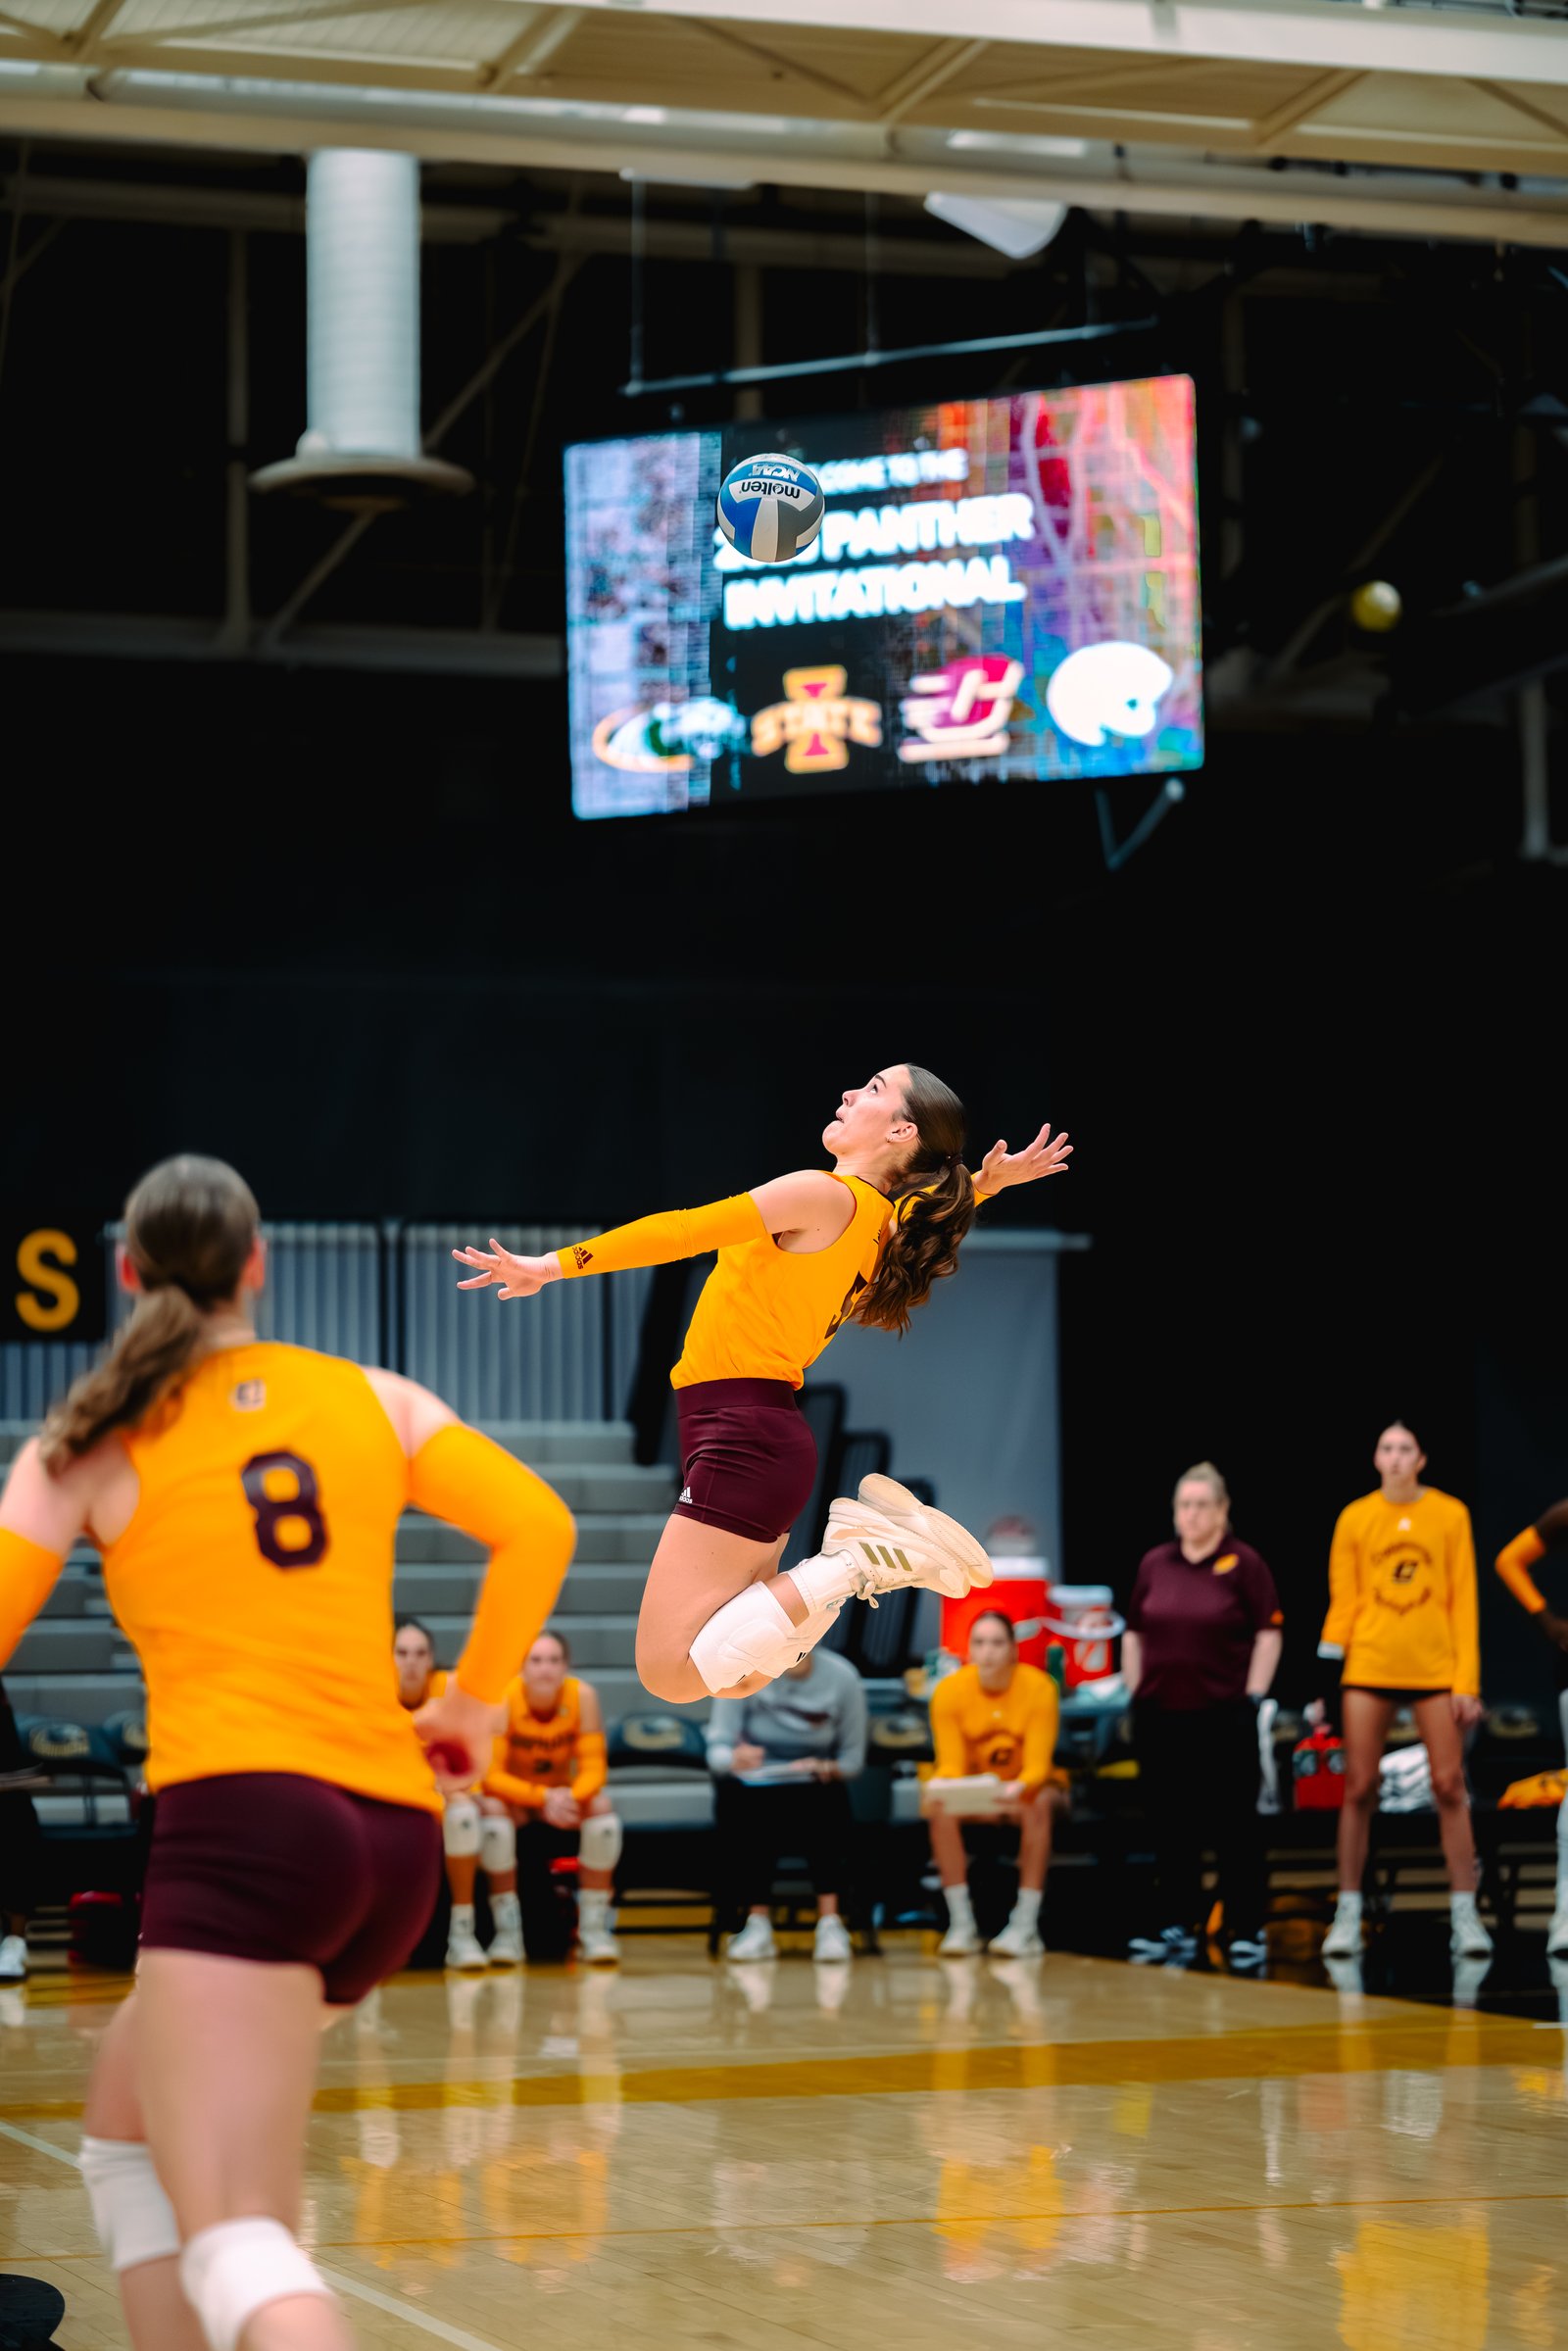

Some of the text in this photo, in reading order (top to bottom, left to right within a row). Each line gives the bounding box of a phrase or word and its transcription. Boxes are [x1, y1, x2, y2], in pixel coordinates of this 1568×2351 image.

[741, 481, 801, 499] molten
[752, 463, 801, 483] NCAA
[821, 493, 1033, 562] PANTHER
[724, 555, 1027, 630] INVITATIONAL
[751, 695, 882, 758] STATE
[15, 1228, 80, 1331] S
[572, 1246, 584, 1270] adidas
[241, 1449, 329, 1571] 8
